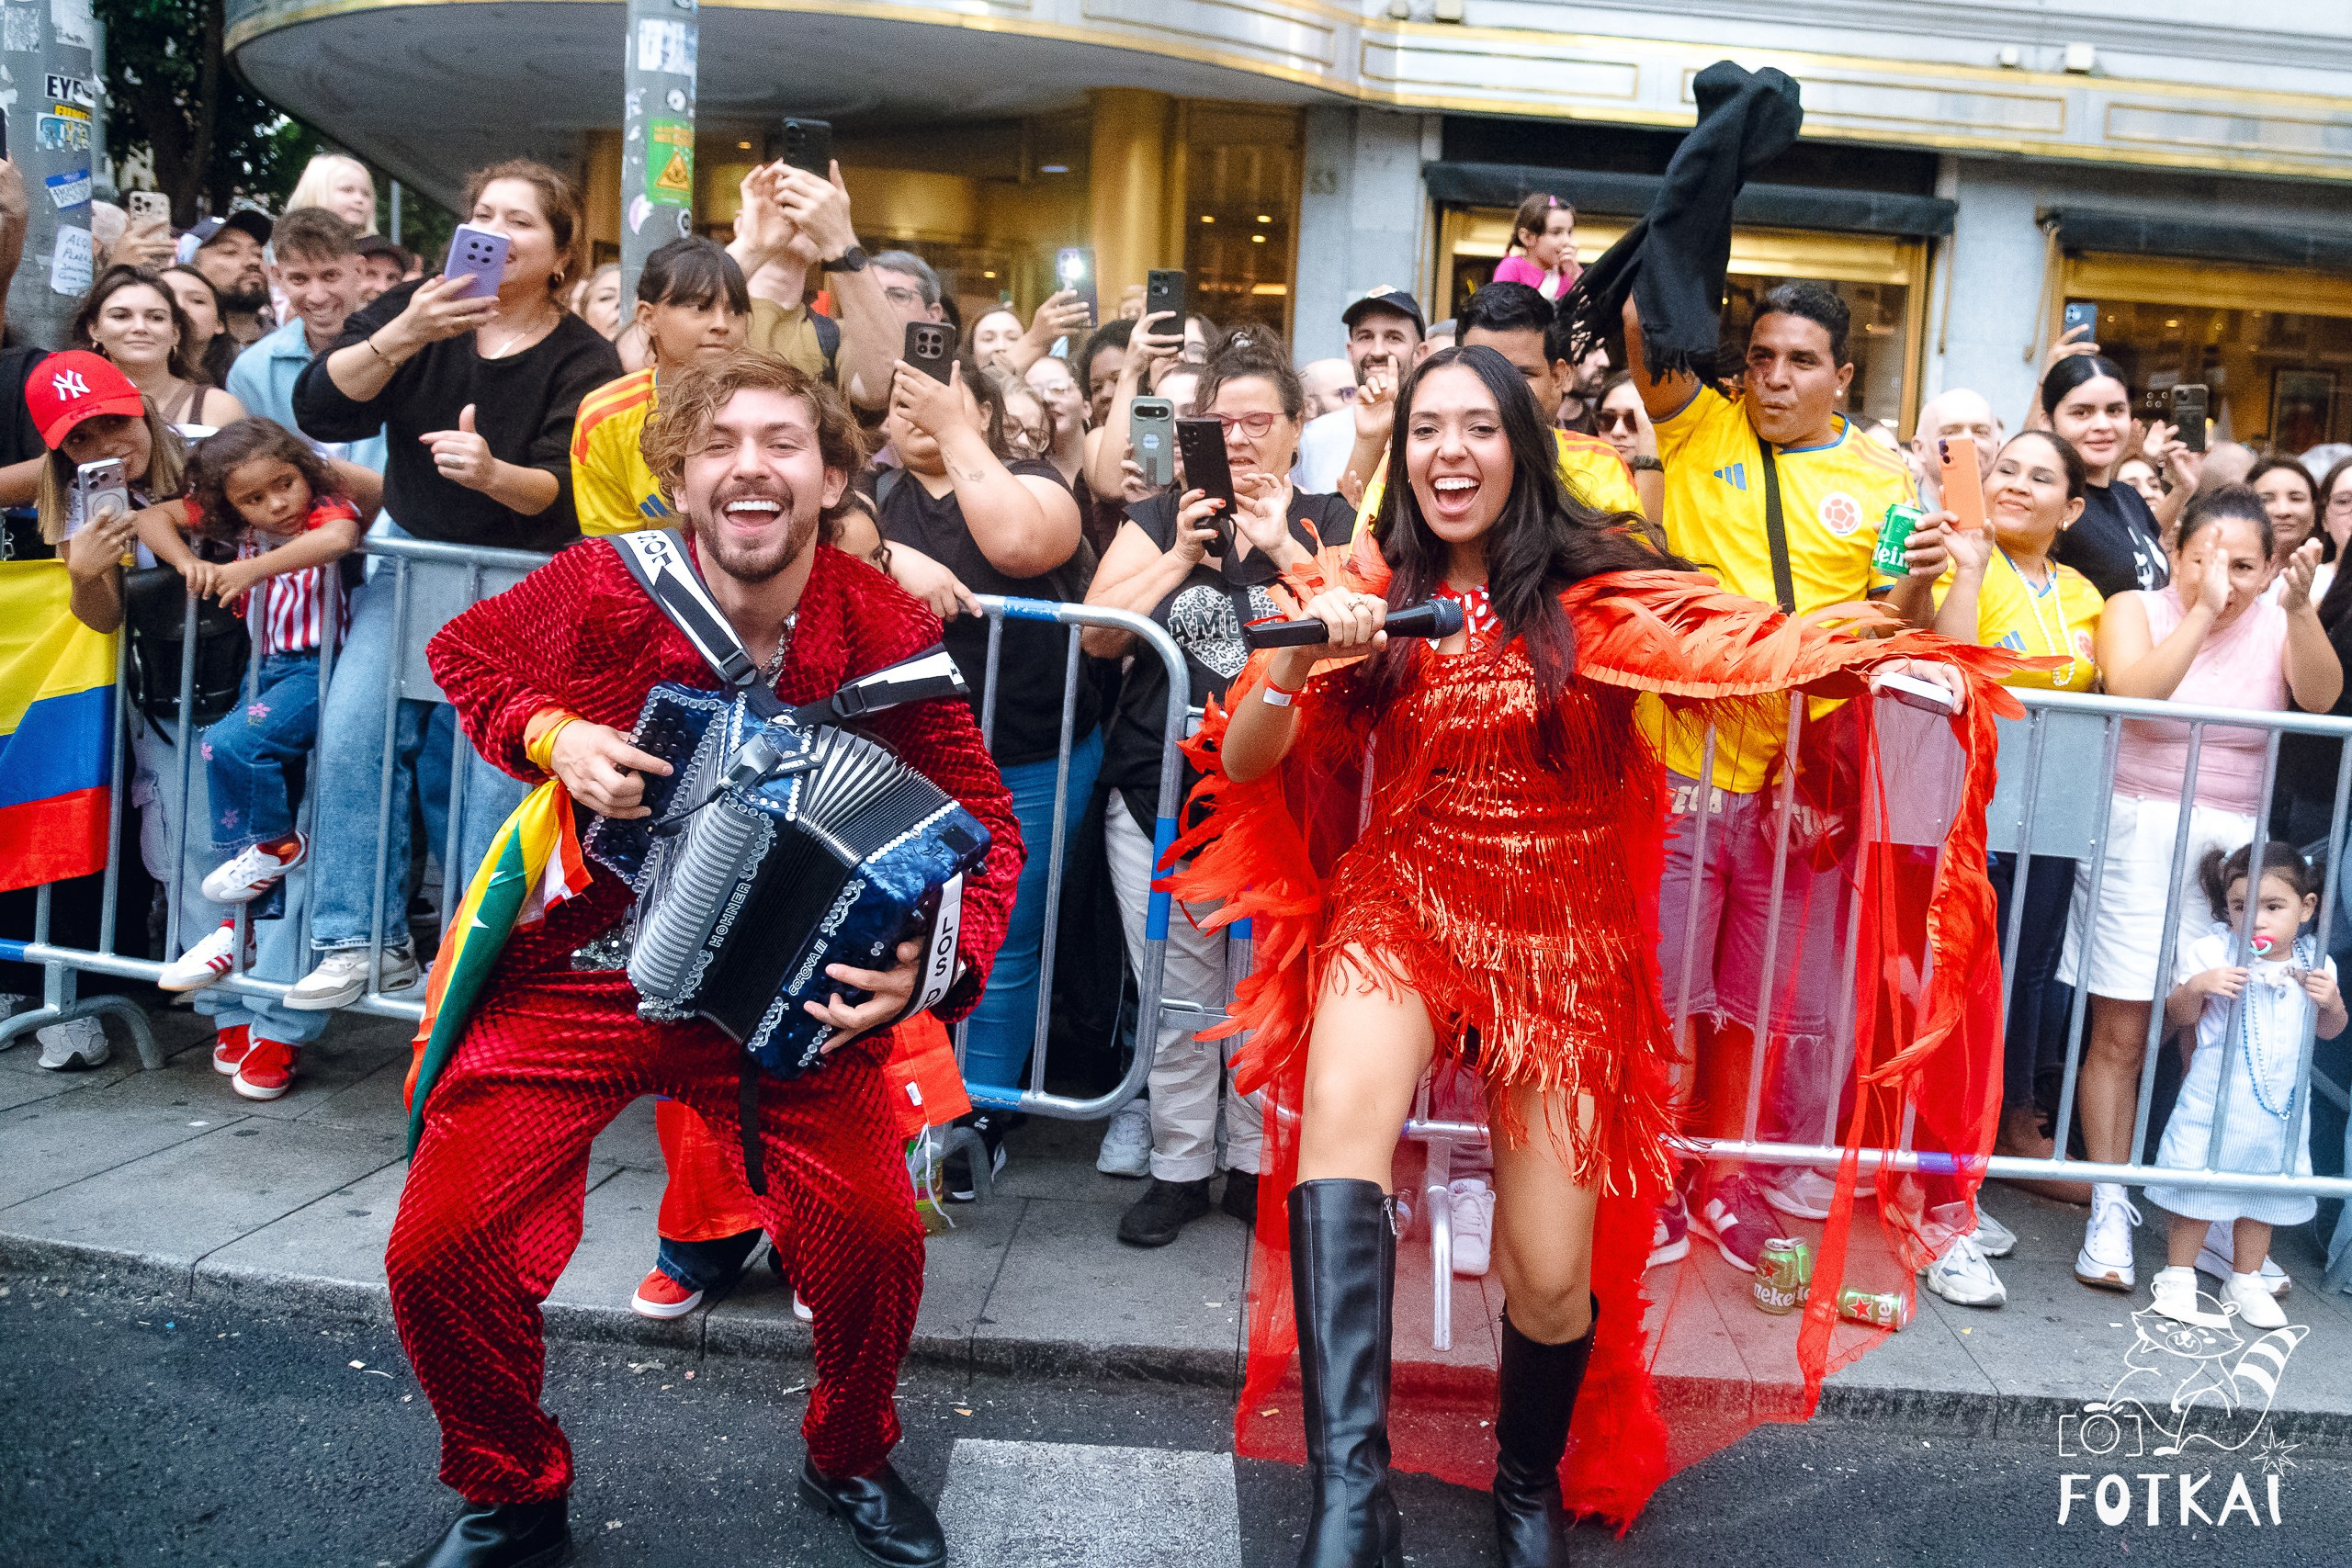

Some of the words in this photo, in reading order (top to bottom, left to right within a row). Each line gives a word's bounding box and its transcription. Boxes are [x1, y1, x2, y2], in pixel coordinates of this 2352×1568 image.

[708, 883, 752, 948] HOHNER
[788, 953, 821, 996] CORONA
[813, 939, 828, 955] III
[934, 916, 954, 976] LOS
